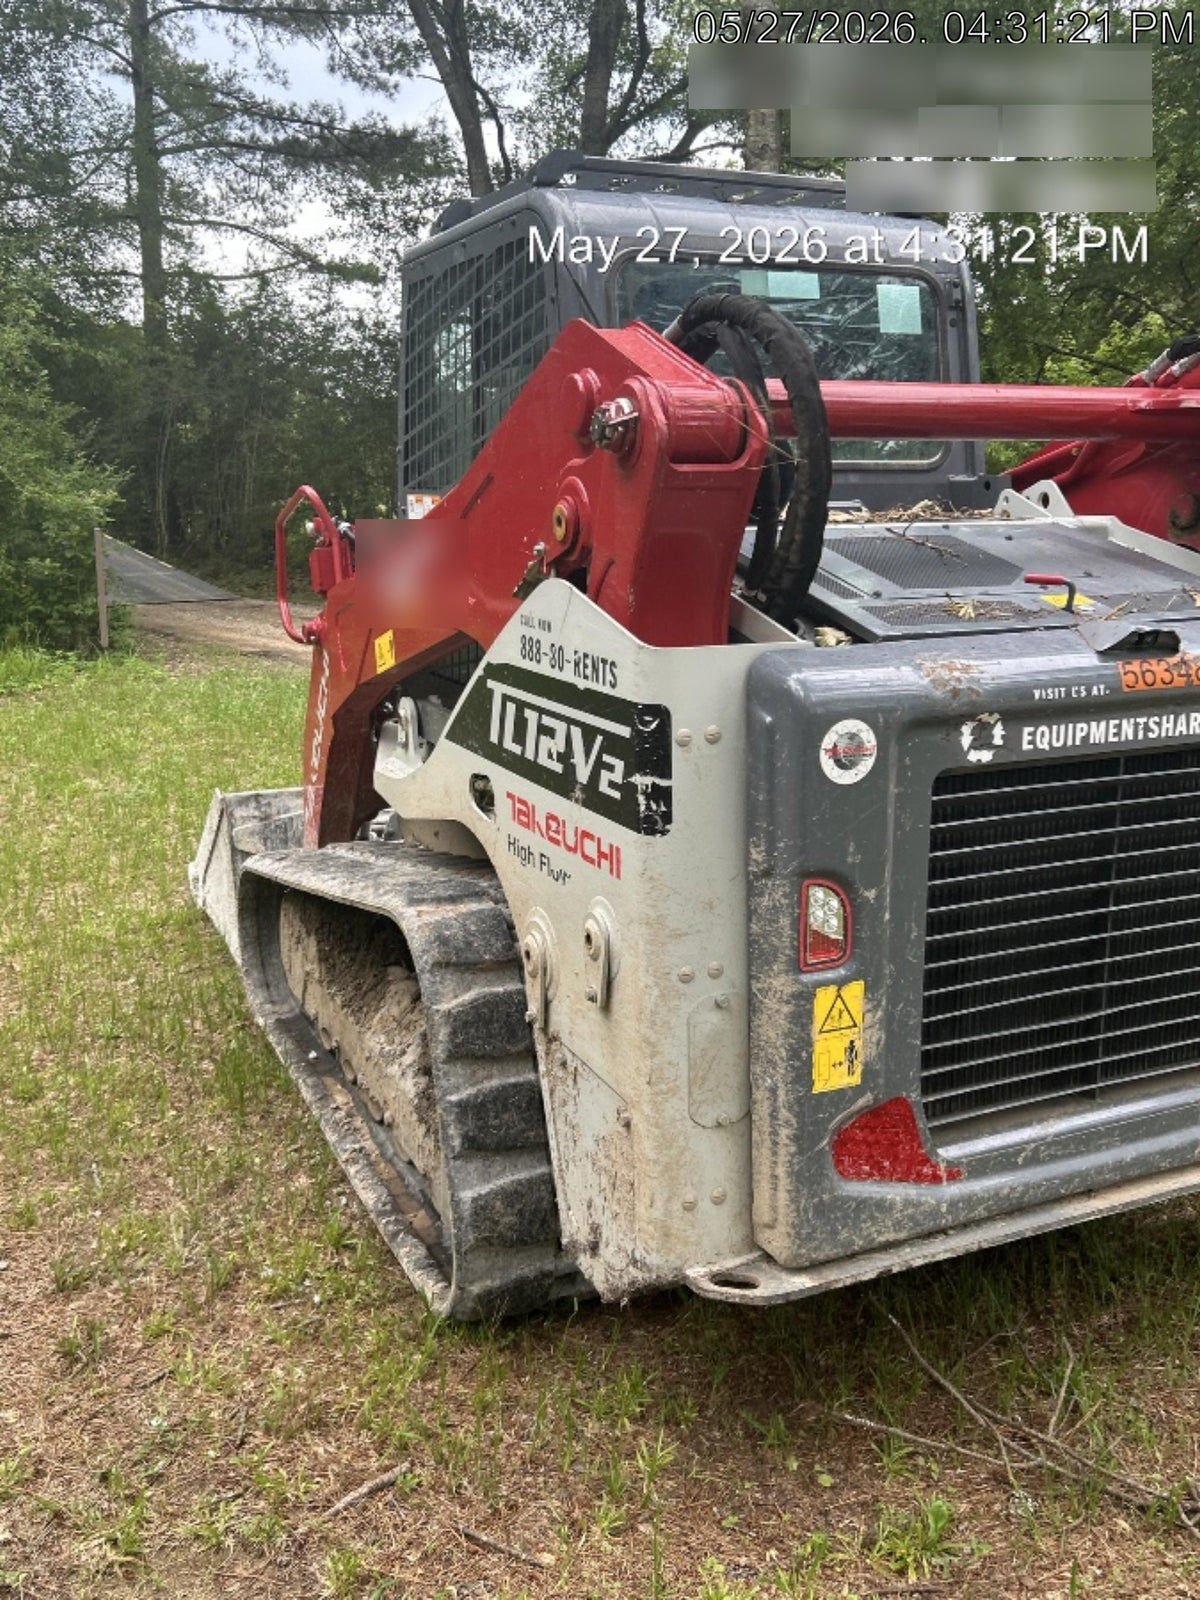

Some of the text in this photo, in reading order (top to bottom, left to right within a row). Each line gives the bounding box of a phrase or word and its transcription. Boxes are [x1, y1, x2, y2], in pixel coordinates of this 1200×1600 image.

[520, 634, 618, 690] 888-80-RENTS
[1033, 687, 1066, 700] VISIT
[507, 833, 536, 868] High
